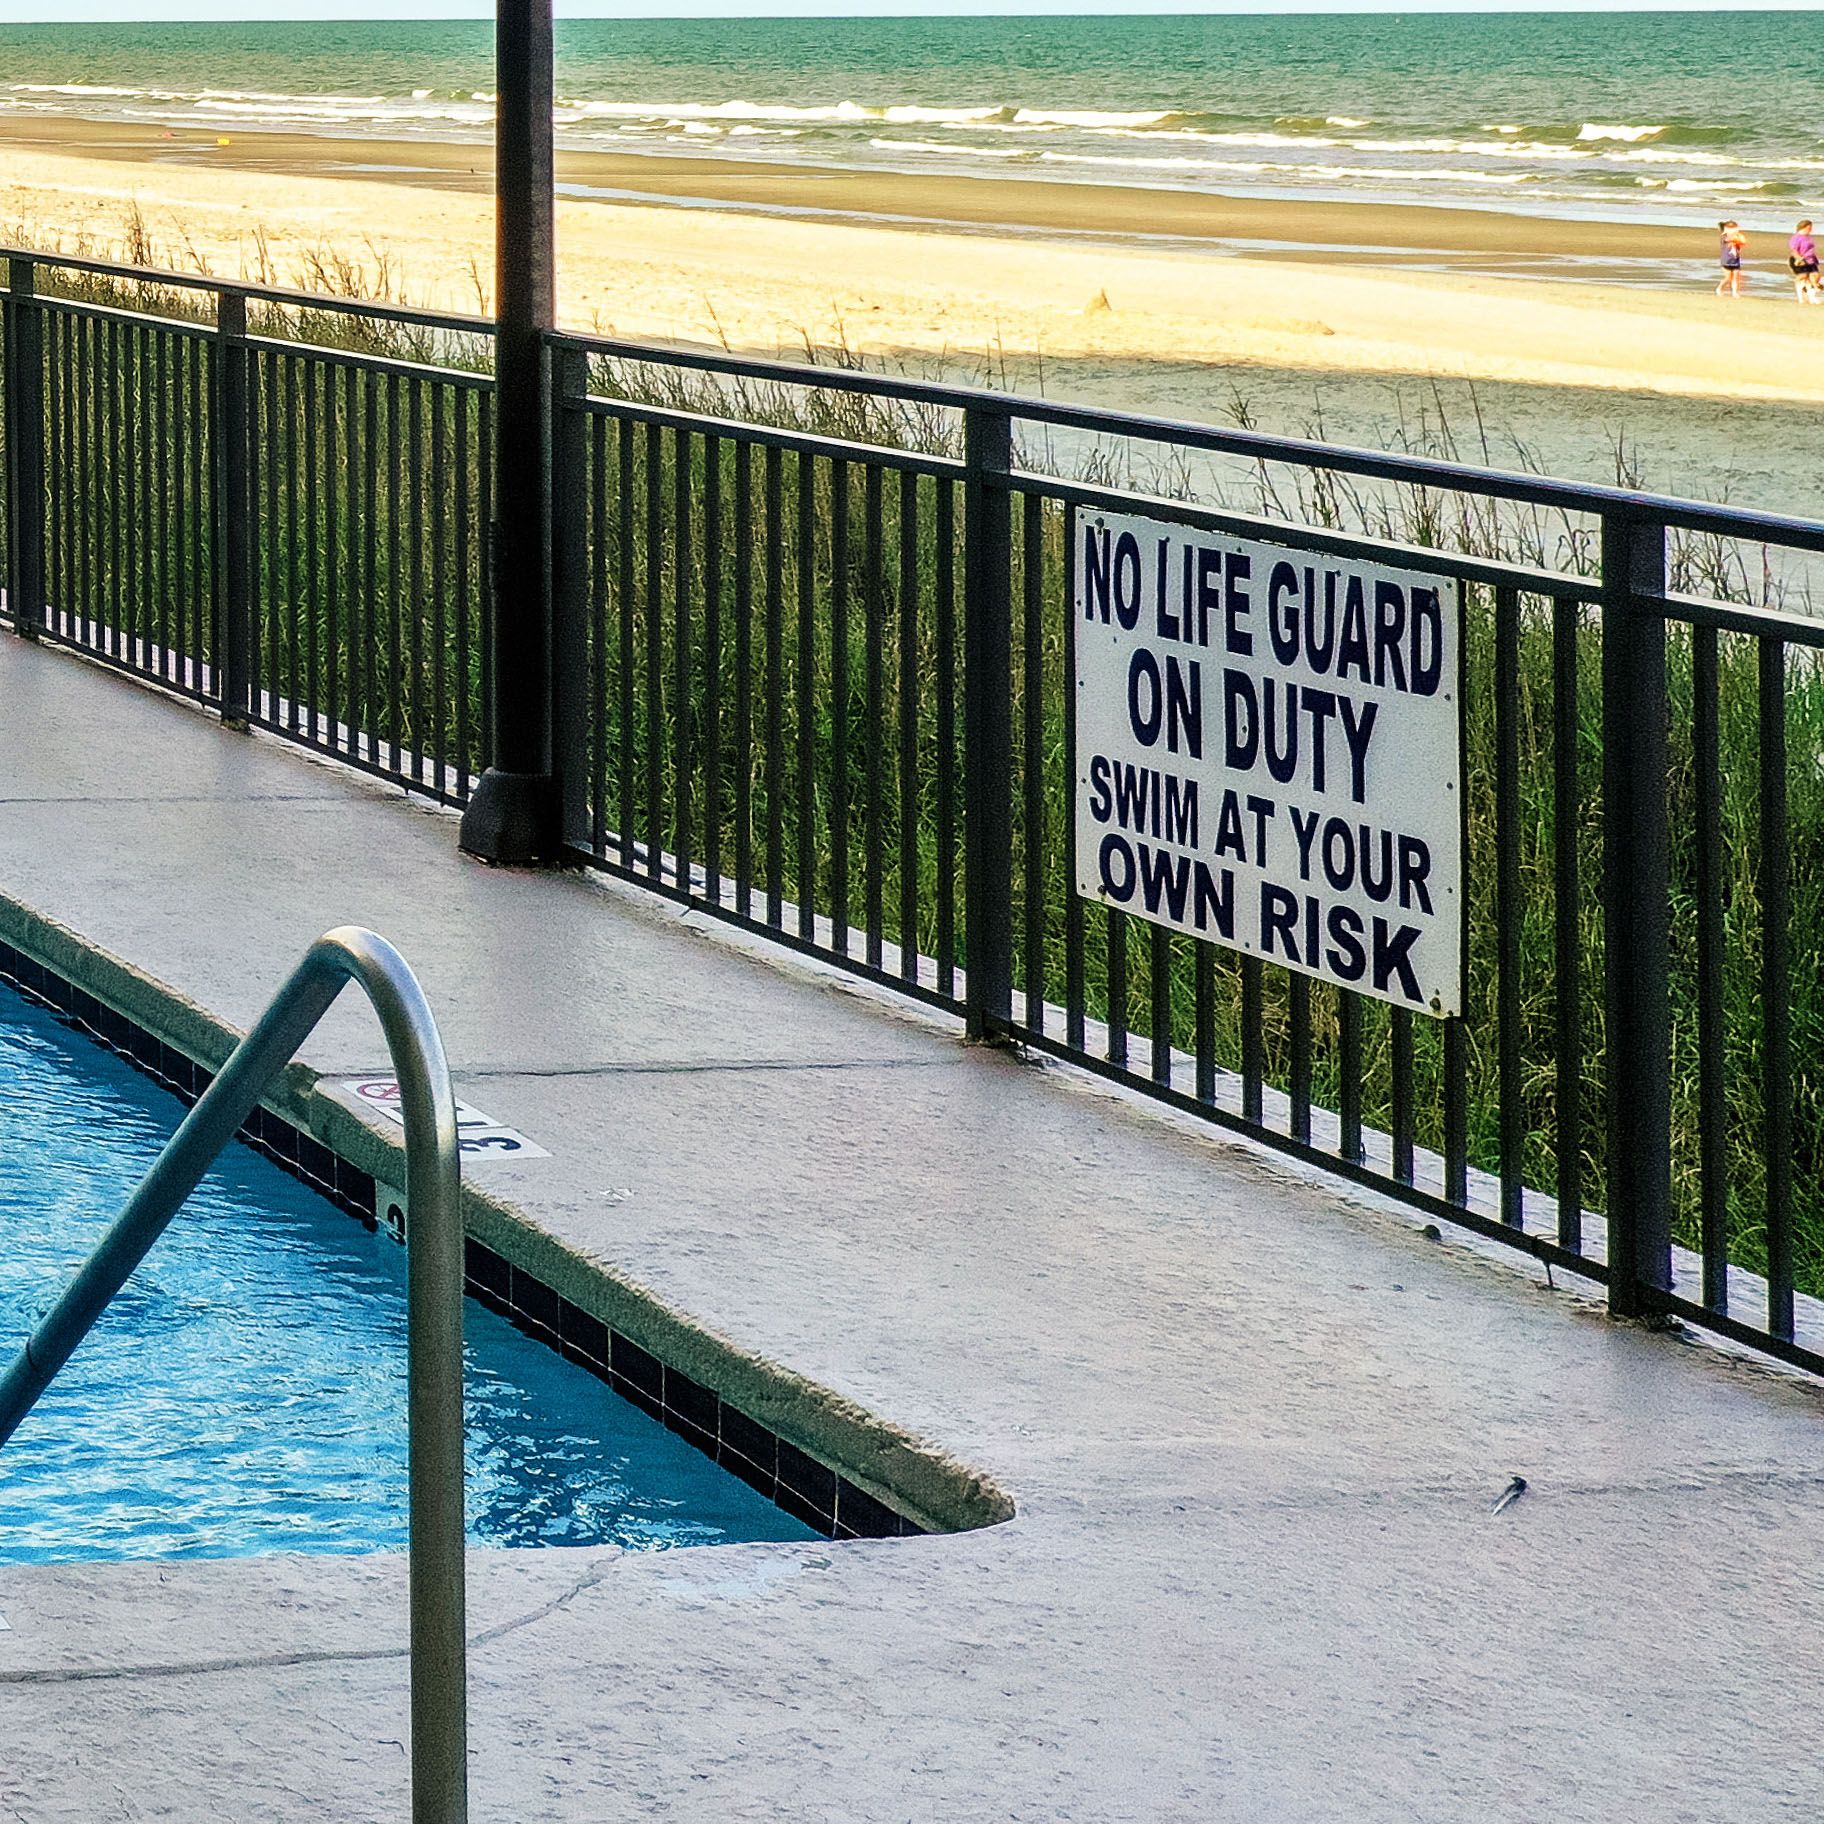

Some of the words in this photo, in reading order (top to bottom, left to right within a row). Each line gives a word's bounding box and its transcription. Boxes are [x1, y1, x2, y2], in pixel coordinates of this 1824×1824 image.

[1084, 525, 1142, 631] NO
[1156, 538, 1252, 657] LIFE
[1268, 561, 1443, 698] GUARD
[1127, 648, 1202, 760] ON
[1223, 668, 1379, 804] DUTY
[1089, 755, 1199, 850] SWIM
[1215, 789, 1275, 869] AT
[1288, 804, 1434, 916] YOUR
[1098, 833, 1235, 941] OWN
[1261, 881, 1426, 1004] RISK
